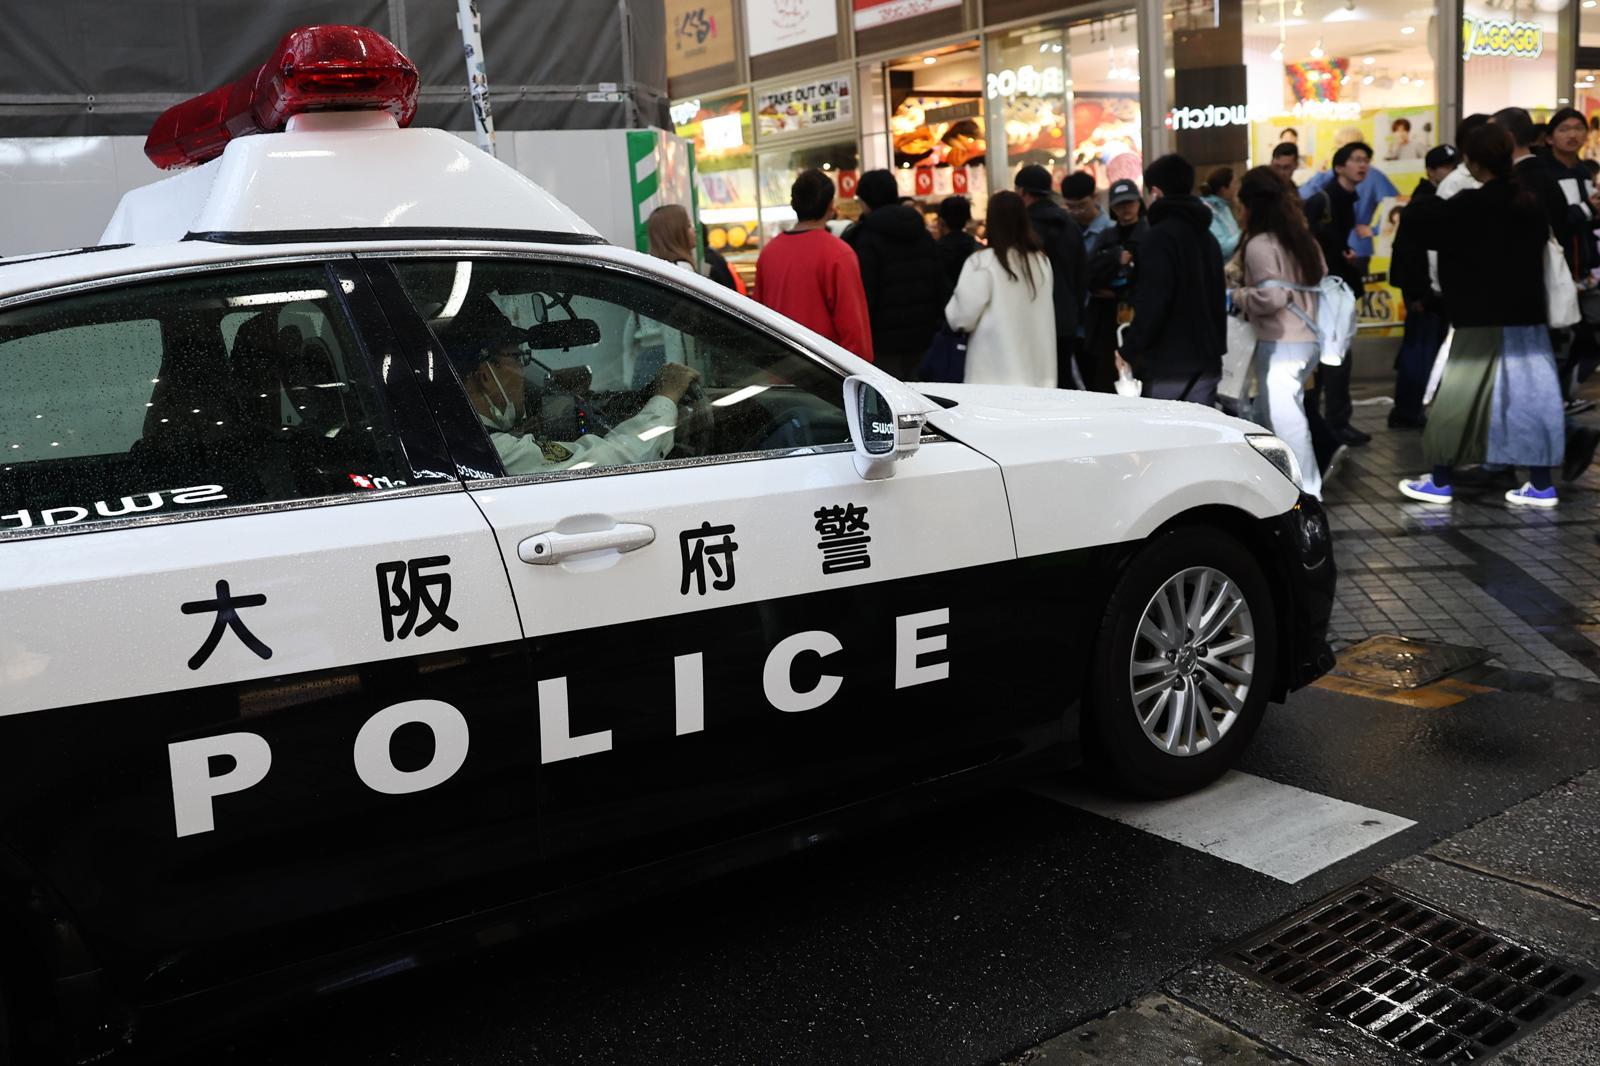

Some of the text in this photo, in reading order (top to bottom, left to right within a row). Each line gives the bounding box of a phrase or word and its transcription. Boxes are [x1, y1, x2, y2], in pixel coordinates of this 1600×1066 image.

[768, 91, 793, 104] TAKE
[795, 86, 817, 101] OUT
[181, 503, 871, 670] 大阪府警
[168, 607, 950, 838] POLICE
